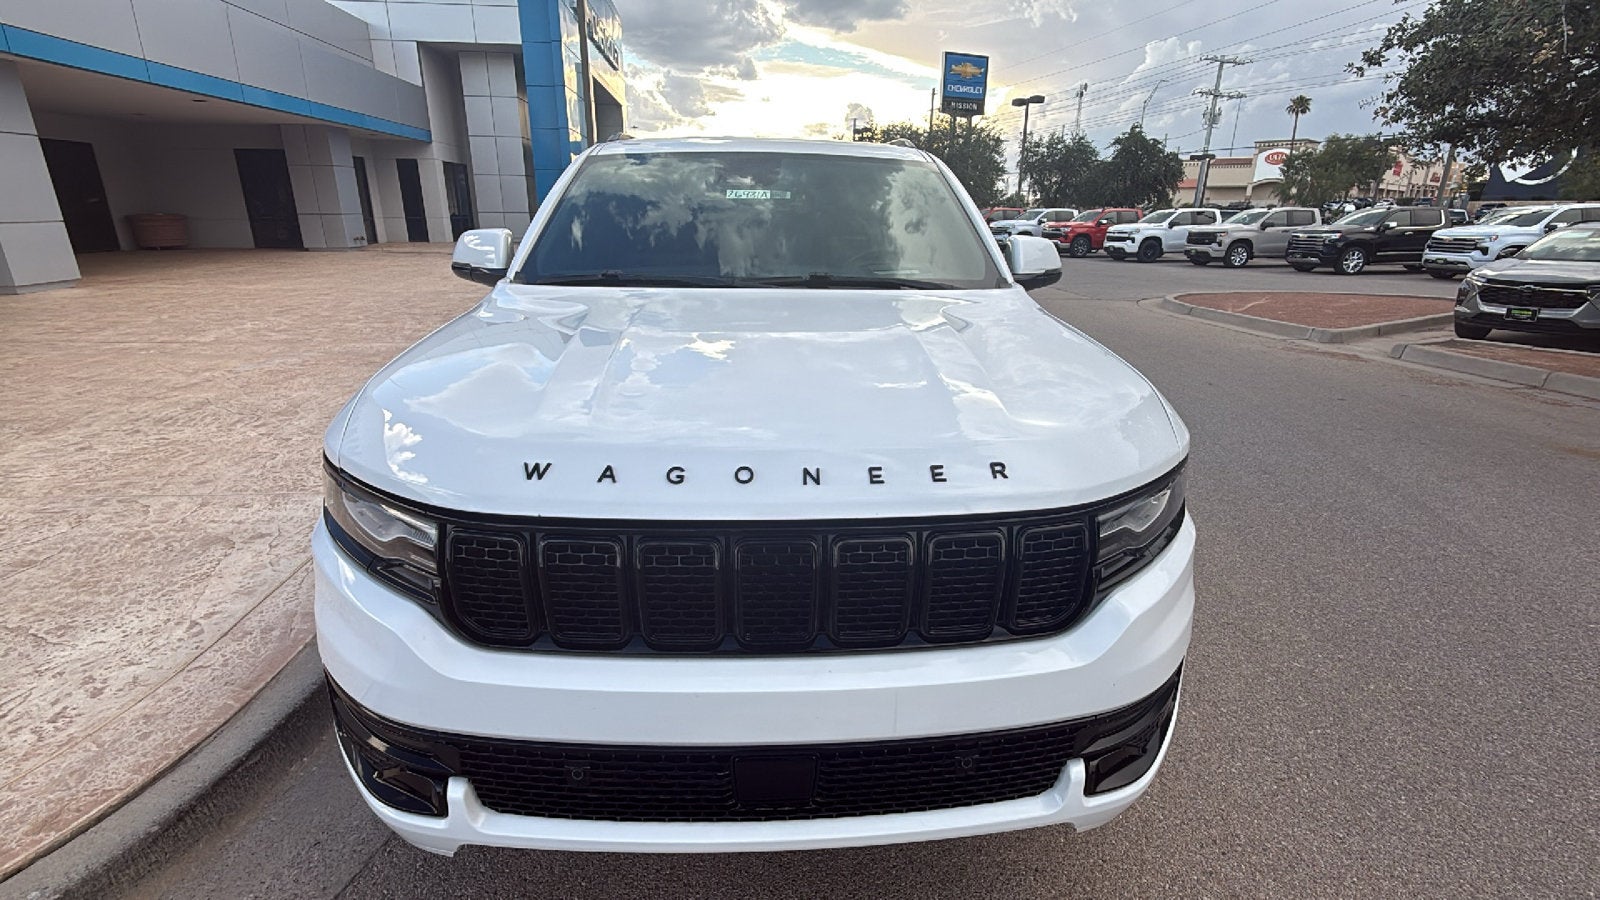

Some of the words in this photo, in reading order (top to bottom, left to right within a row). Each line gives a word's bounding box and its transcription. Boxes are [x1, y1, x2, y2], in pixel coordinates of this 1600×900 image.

[947, 84, 984, 94] CHEVROLET
[951, 101, 978, 111] MISSION
[523, 461, 1009, 486] WAGONEER
